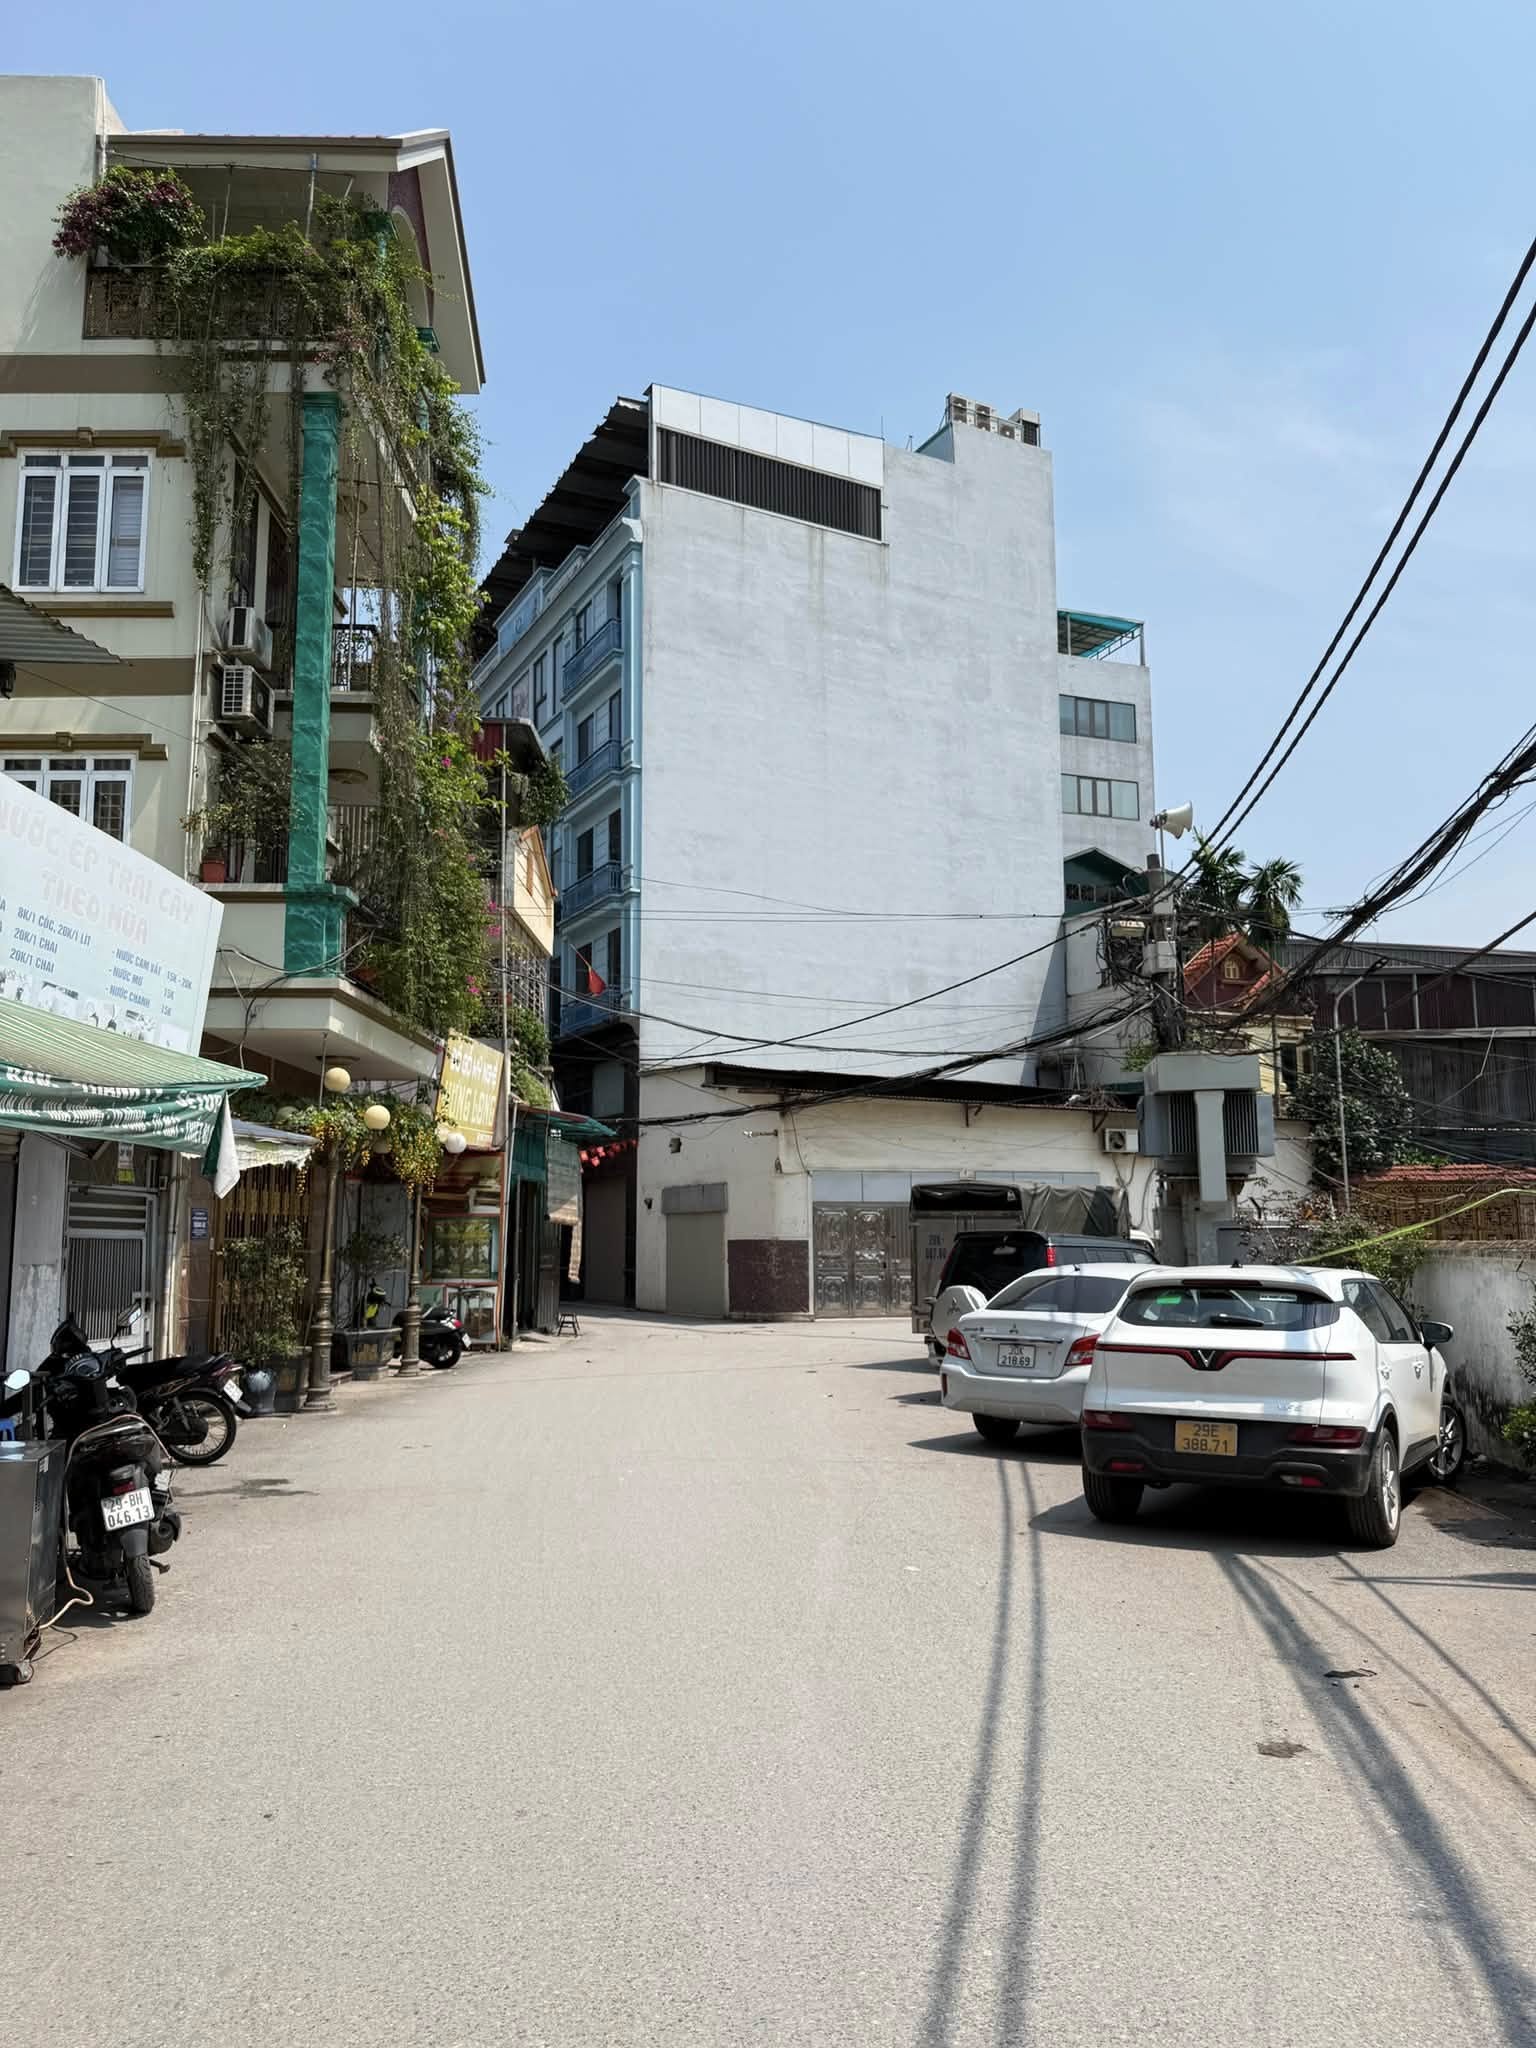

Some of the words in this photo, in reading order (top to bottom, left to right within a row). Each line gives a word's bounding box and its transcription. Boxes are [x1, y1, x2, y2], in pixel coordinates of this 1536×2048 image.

[39, 937, 58, 954] CHAI
[35, 957, 55, 973] CHAI
[1193, 1423, 1220, 1437] 29E
[1183, 1438, 1228, 1453] 388.71
[110, 1492, 144, 1513] 29-BH
[107, 1505, 150, 1528] 046.13
